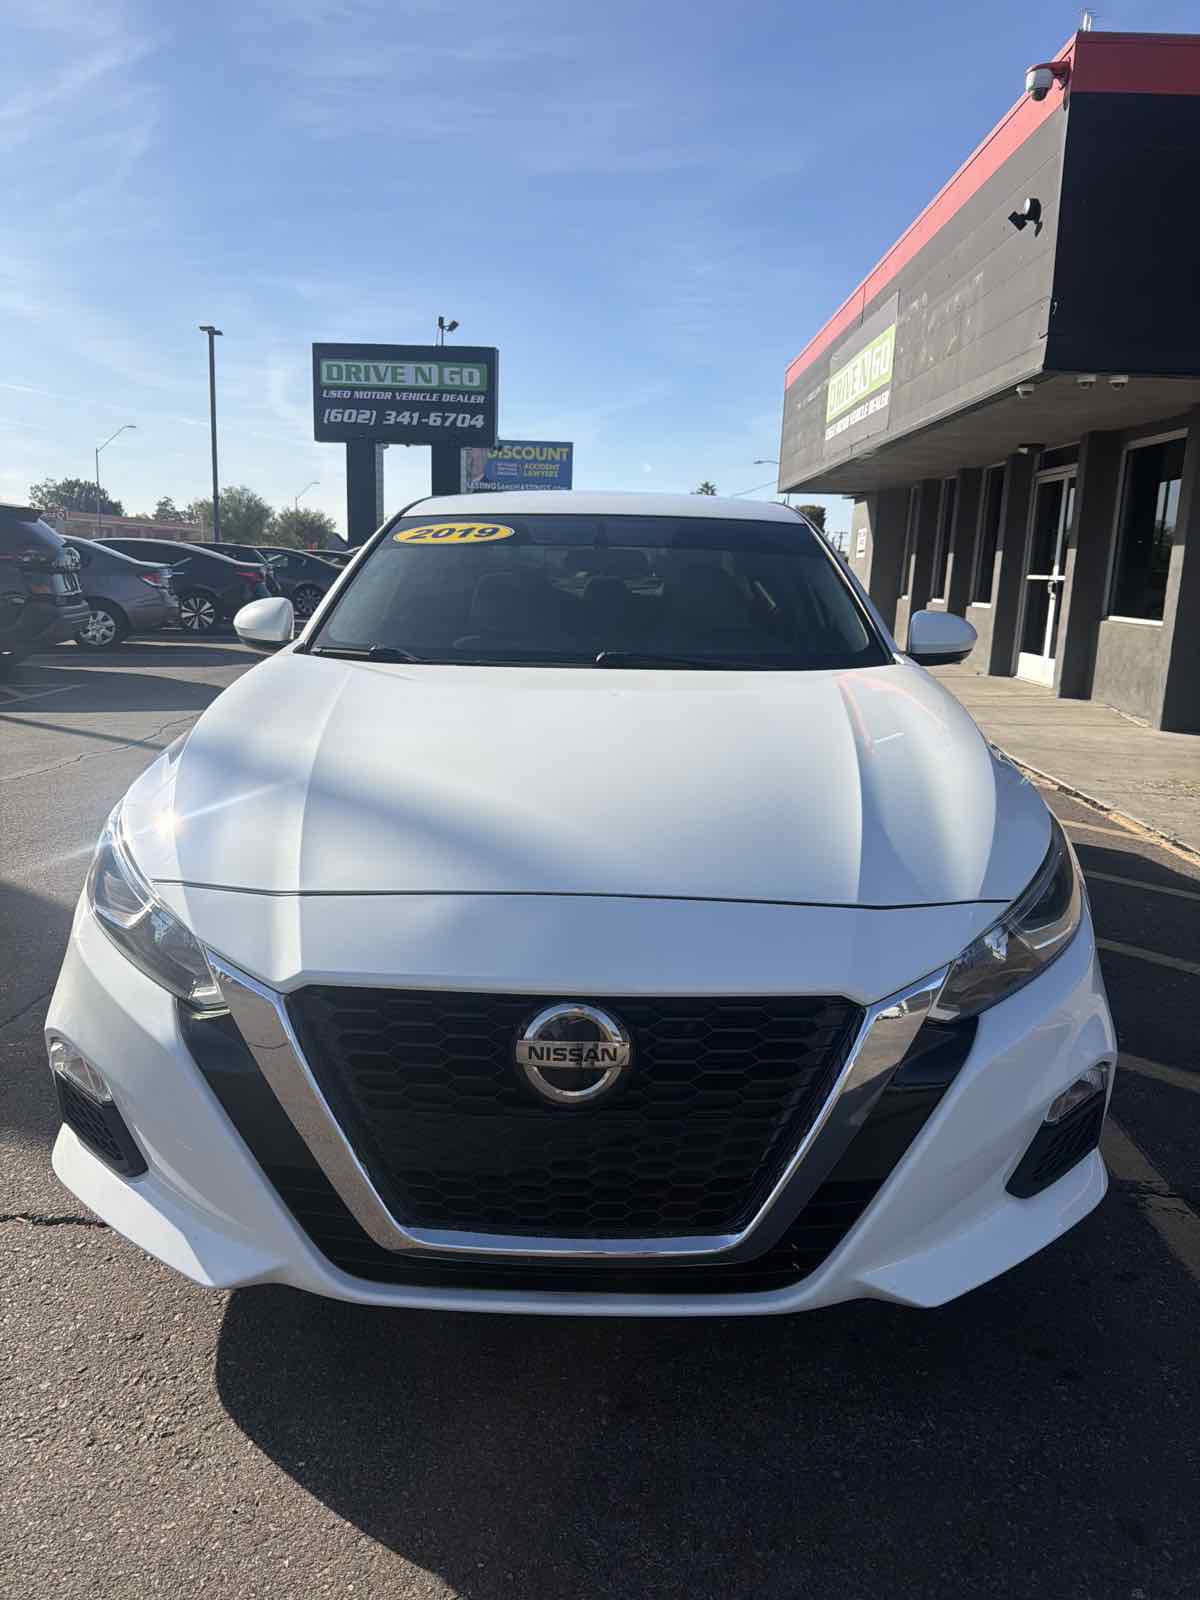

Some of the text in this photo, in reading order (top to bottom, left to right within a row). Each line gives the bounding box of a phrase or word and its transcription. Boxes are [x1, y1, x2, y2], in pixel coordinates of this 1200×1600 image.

[871, 338, 890, 381] GO
[326, 363, 481, 386] DRIVE N GO
[323, 389, 485, 404] USED MOTOR VEHICLE DEALER
[323, 408, 485, 428] (602) 341-6704
[406, 527, 500, 540] 2019
[528, 1046, 618, 1062] NISSAN
